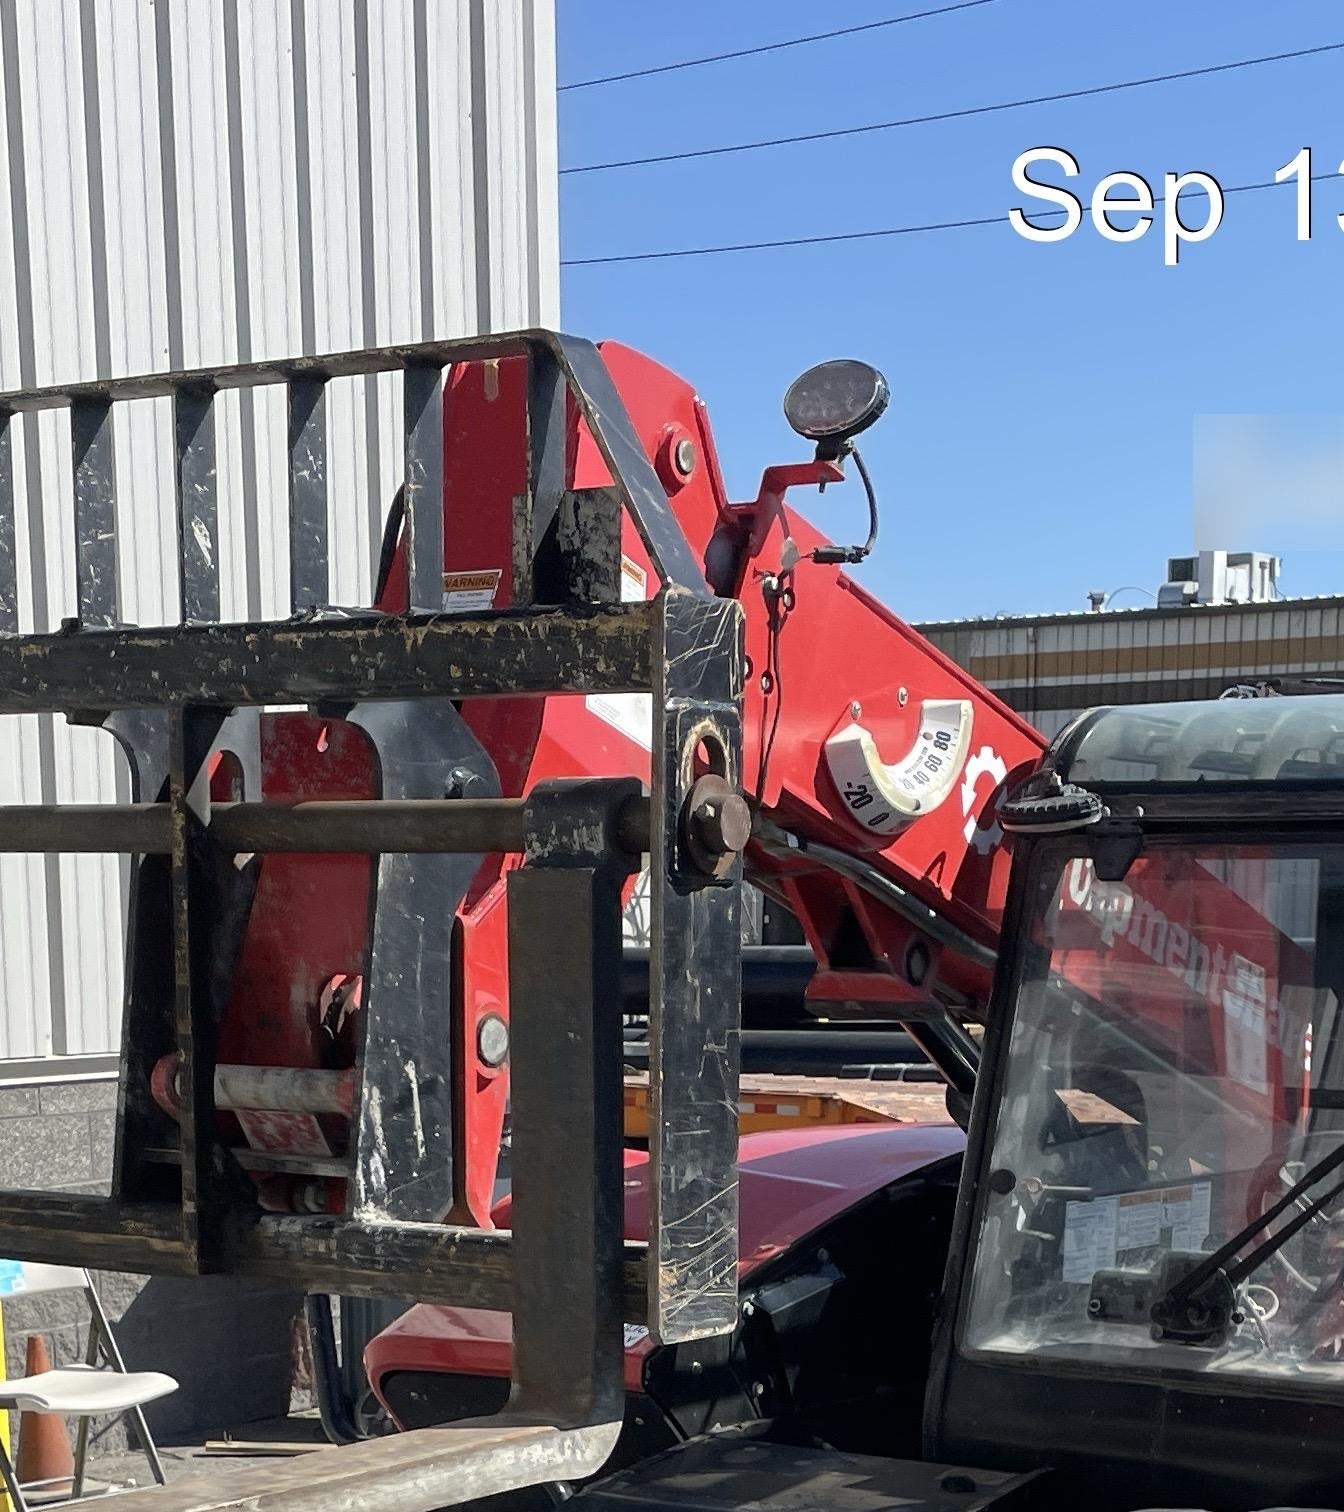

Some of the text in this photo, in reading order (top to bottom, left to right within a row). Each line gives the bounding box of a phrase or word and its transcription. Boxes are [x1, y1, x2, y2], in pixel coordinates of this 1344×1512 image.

[933, 731, 952, 751] 80
[924, 754, 943, 773] 60
[843, 782, 874, 809] -20
